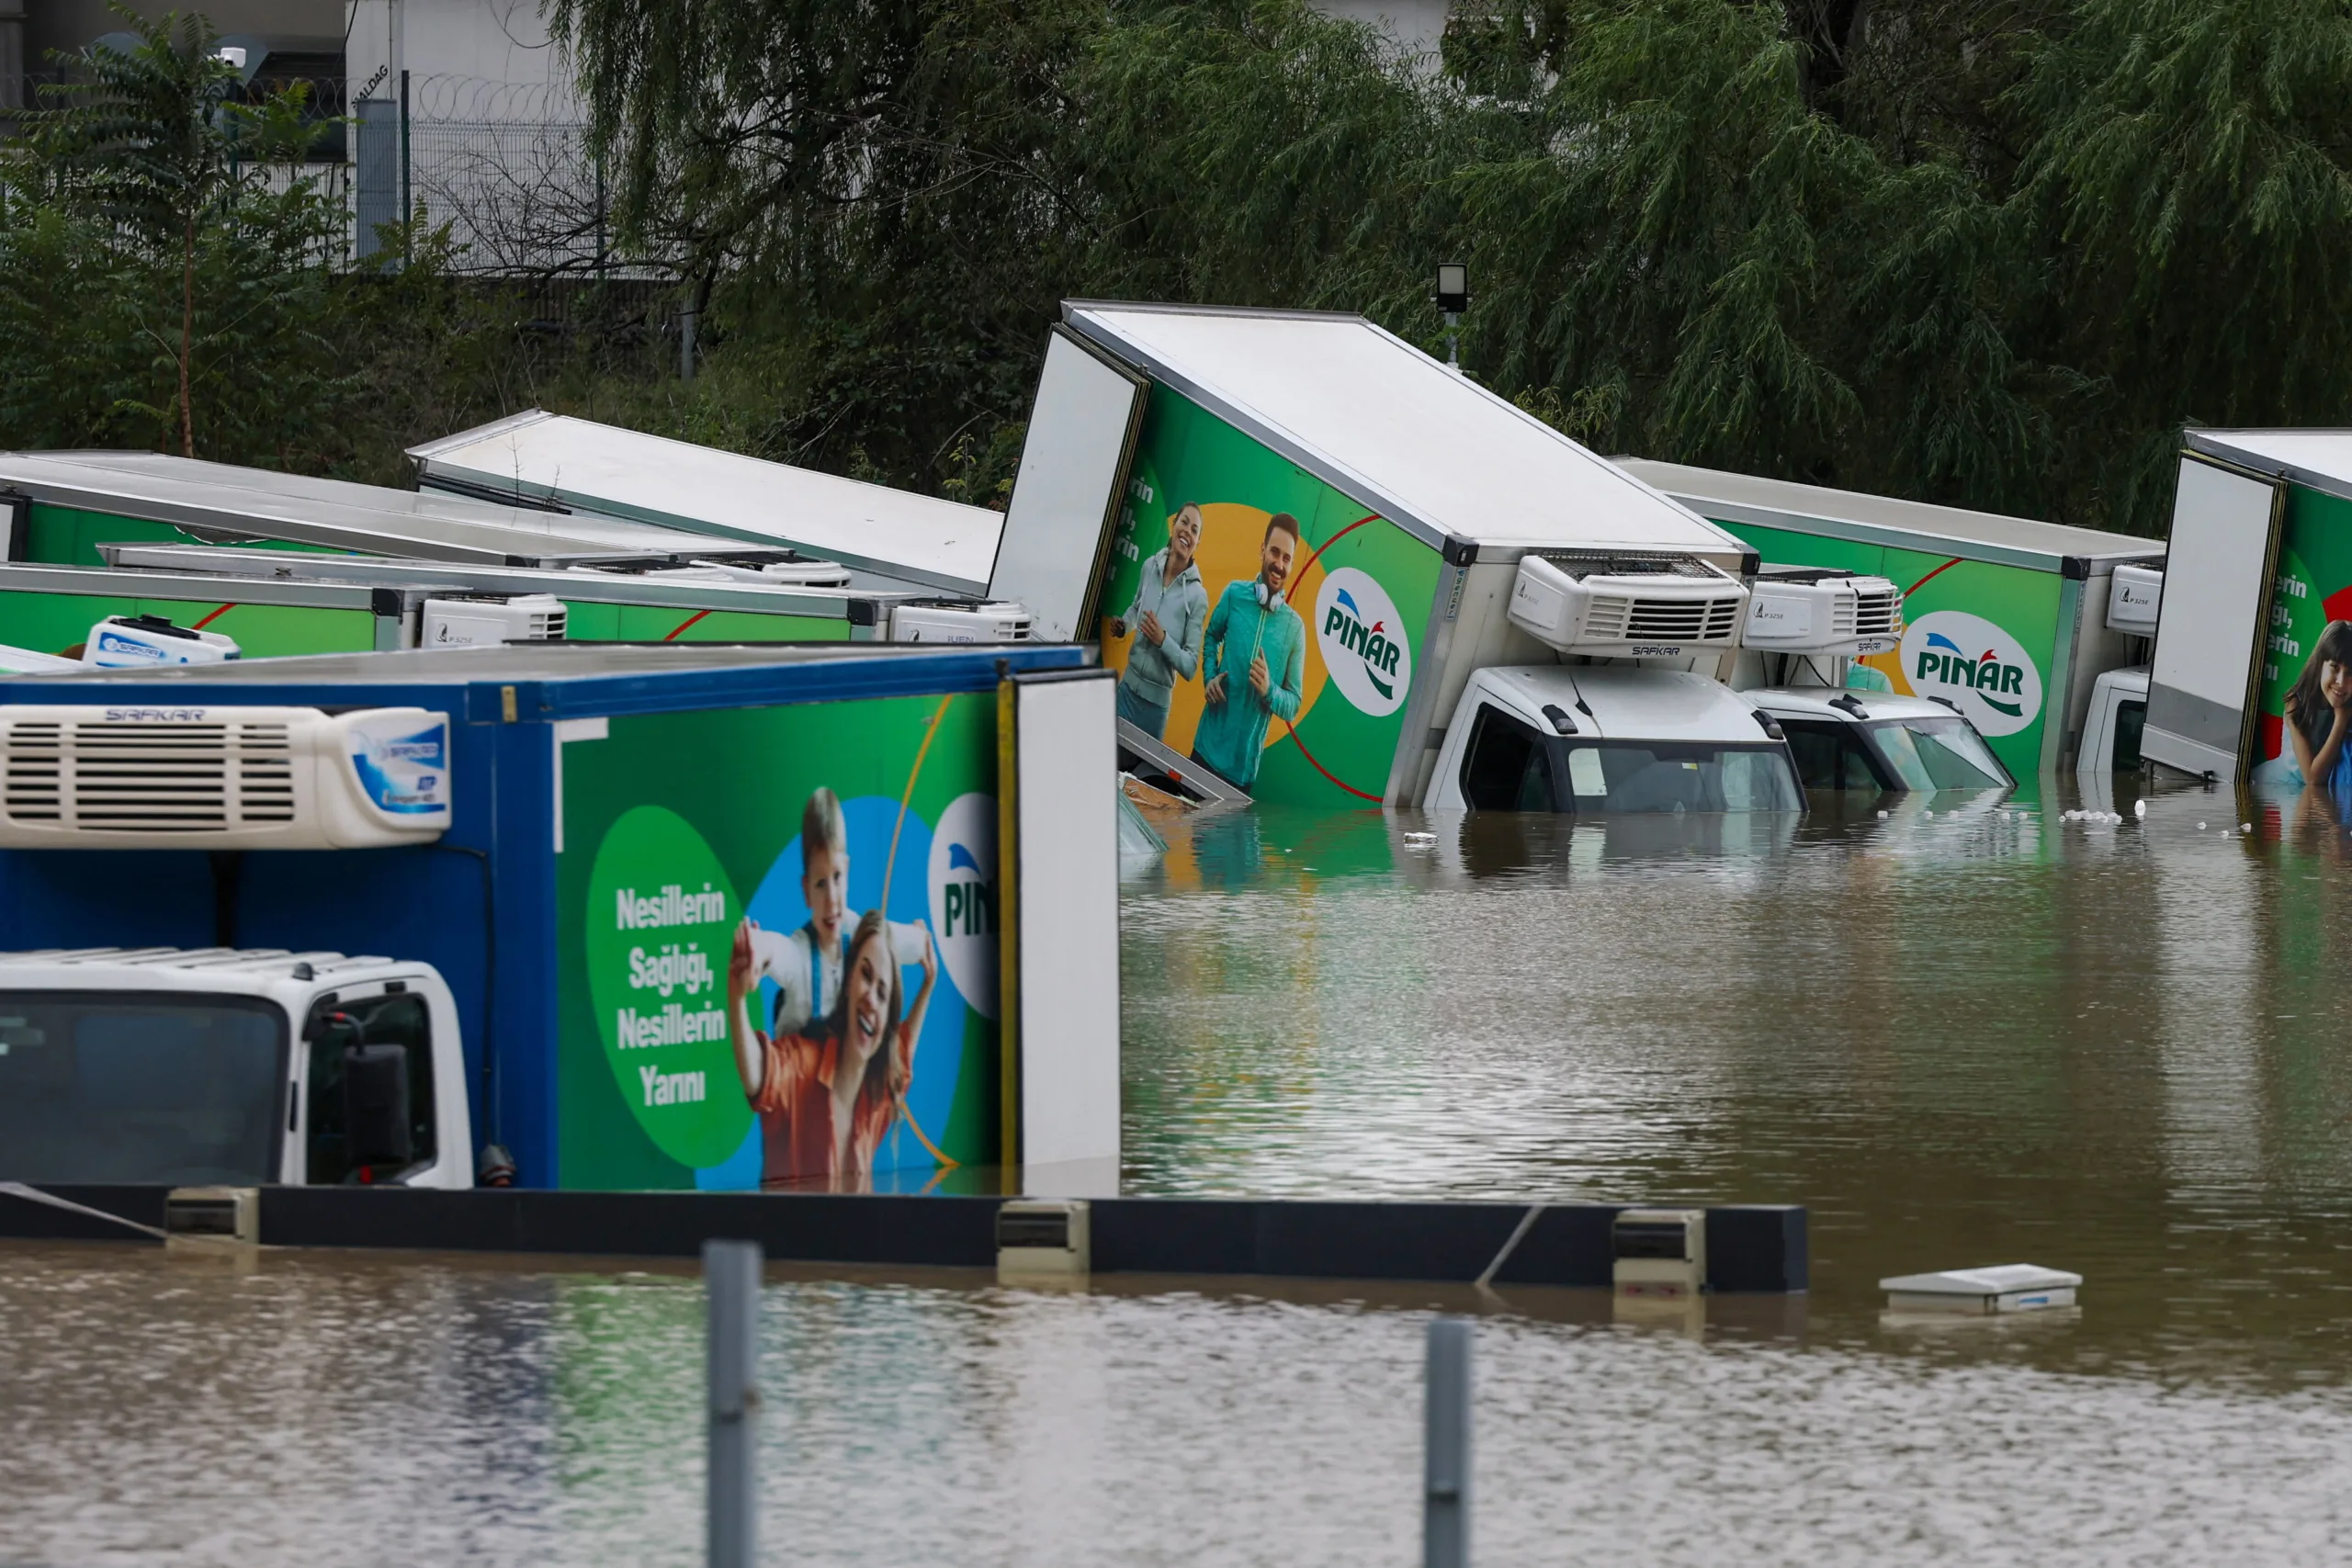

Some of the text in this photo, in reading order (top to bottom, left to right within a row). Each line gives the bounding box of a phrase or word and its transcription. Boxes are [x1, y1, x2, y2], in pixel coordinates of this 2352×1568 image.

[1631, 647, 1681, 656] SAFKAR
[105, 708, 207, 722] SAFKAR
[616, 882, 726, 931] Nesillerin
[944, 880, 999, 938] PIN
[617, 1000, 727, 1050] Nesillerin
